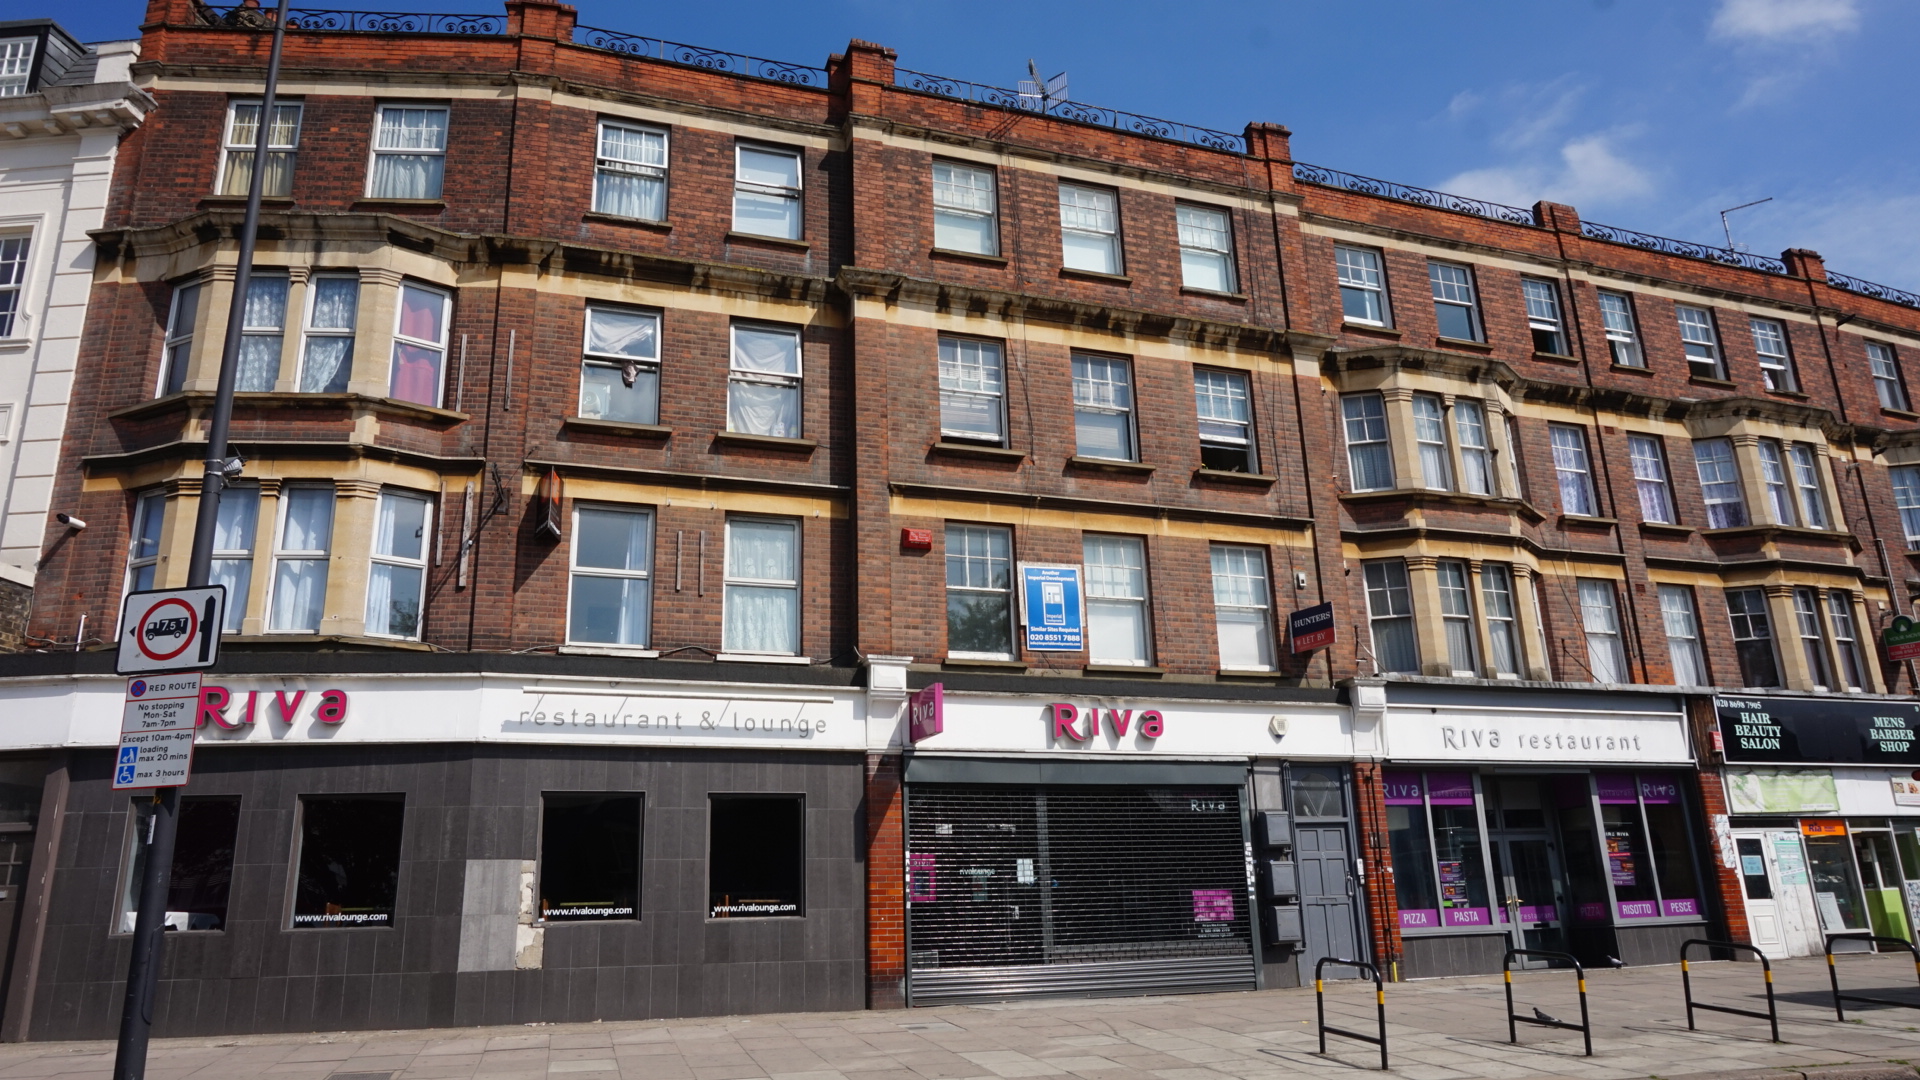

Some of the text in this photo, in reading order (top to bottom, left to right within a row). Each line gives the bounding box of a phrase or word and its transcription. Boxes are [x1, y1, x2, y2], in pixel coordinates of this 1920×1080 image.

[1294, 611, 1331, 628] HUNTERS
[161, 620, 176, 631] 7.5
[1303, 635, 1315, 645] LET
[1317, 632, 1326, 641] BY
[149, 682, 197, 692] RED ROUTE
[138, 702, 184, 711] No stopping
[1716, 699, 1729, 708] 020
[143, 710, 176, 719] Mon-Sat
[1740, 712, 1772, 724] HAIR
[142, 719, 176, 728] 7am-7pm
[519, 708, 827, 738] restaurant & lounge
[1873, 716, 1906, 728] MENS
[1734, 725, 1782, 737] BEAUTY
[1869, 729, 1916, 740] BARBER
[122, 732, 192, 743] Except 10am-4pm
[1518, 732, 1641, 751] restaurant
[1740, 737, 1781, 749] SALON
[140, 746, 168, 754] loading
[1880, 741, 1910, 752] SHOP
[157, 753, 168, 761] 20
[543, 906, 633, 916] www.rivalounge.com
[713, 903, 797, 913] www.rivalounge.com
[1622, 904, 1652, 914] RISOTTO
[1670, 902, 1693, 912] PESCE
[295, 912, 388, 923] www.rivalounge.com
[1403, 913, 1427, 924] PIZZA
[1454, 911, 1479, 922] PASTA
